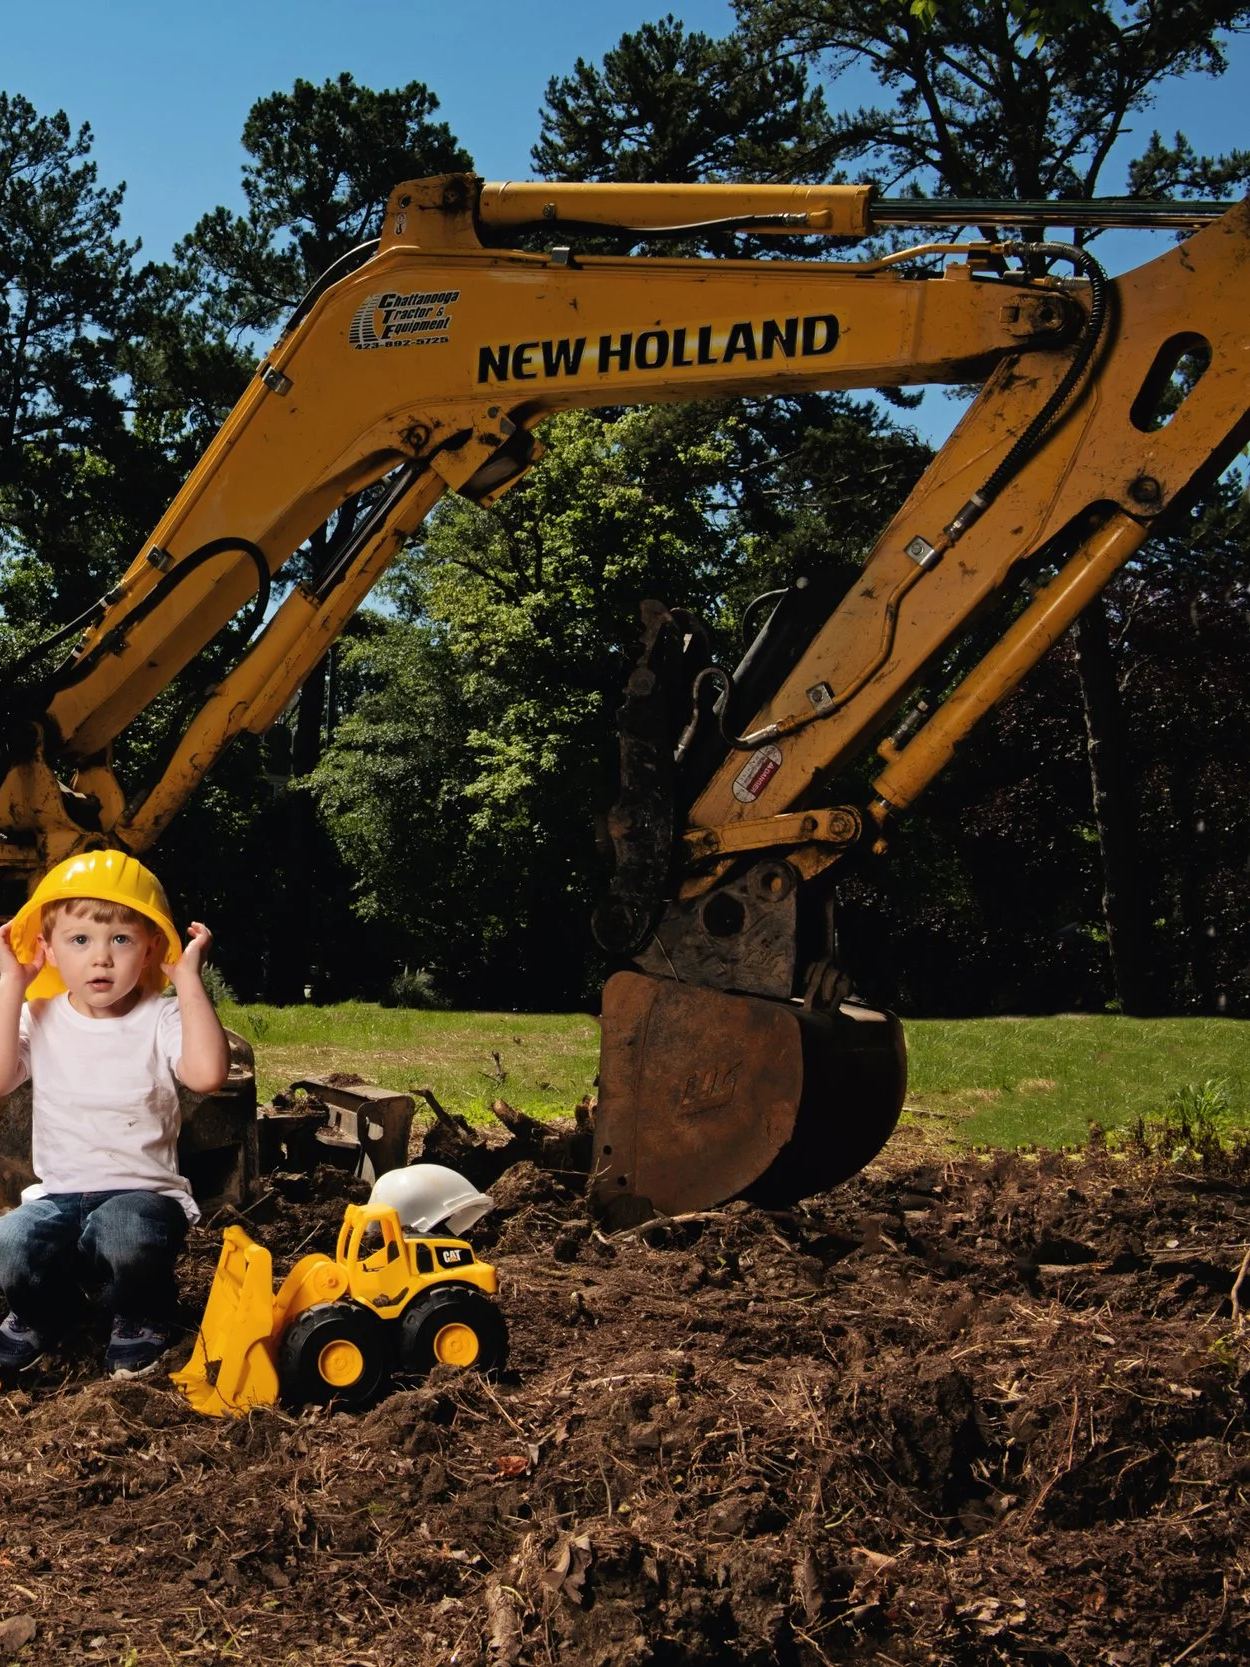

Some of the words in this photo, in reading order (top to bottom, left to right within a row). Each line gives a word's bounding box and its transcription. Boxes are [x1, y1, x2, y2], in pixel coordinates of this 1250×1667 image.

[378, 291, 460, 308] Chattanooga
[382, 307, 434, 324] Tractor
[436, 306, 444, 317] &
[381, 317, 451, 340] Equipment
[477, 336, 587, 384] NEW
[598, 313, 840, 374] HOLLAND
[442, 1249, 462, 1263] CAT
